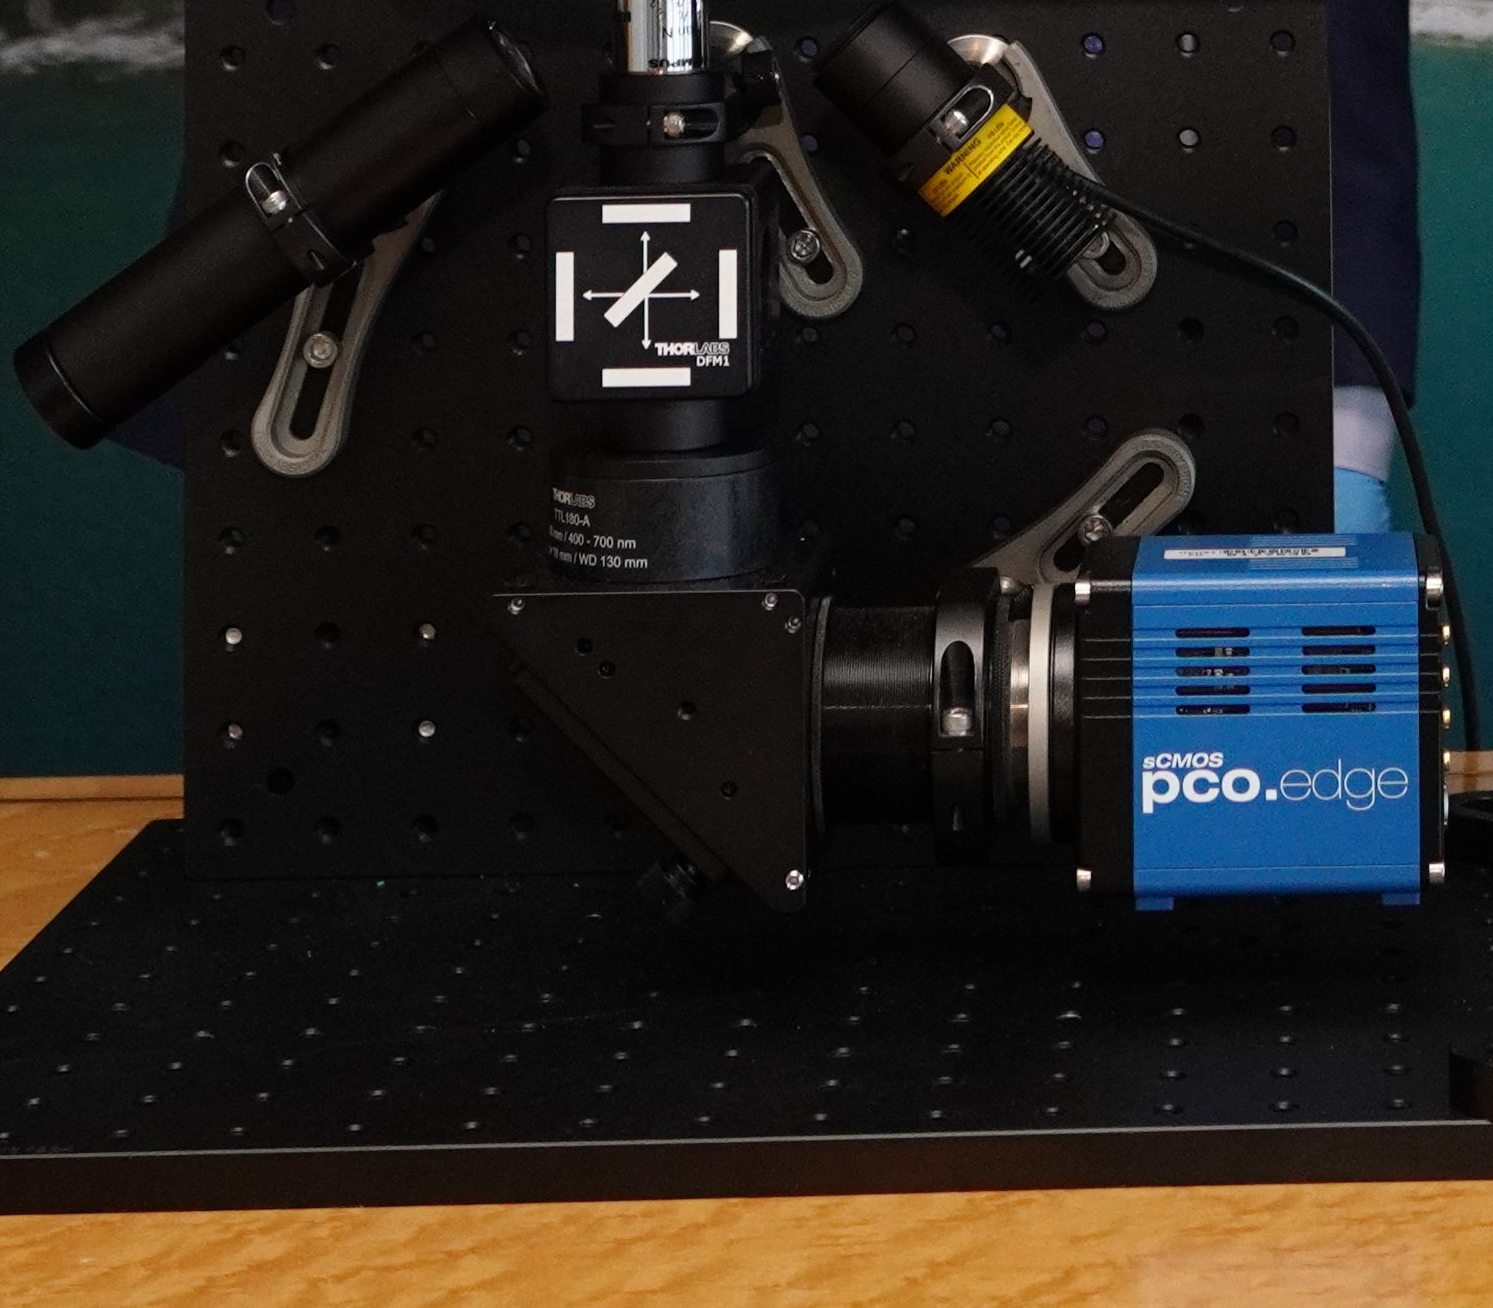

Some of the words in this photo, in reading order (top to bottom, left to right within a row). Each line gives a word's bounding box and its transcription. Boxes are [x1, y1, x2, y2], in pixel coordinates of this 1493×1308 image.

[943, 138, 982, 175] WARNING
[654, 341, 730, 356] THORLABS
[696, 355, 730, 367] DFM1
[552, 487, 596, 510] THORLABS
[568, 532, 584, 546] 400
[593, 535, 614, 549] 700
[616, 538, 637, 550] nm
[578, 553, 597, 567] WD
[600, 555, 621, 568] 130
[624, 558, 648, 569] mm
[1142, 752, 1225, 769] sCMOS
[1141, 758, 1409, 814] pco.edge
